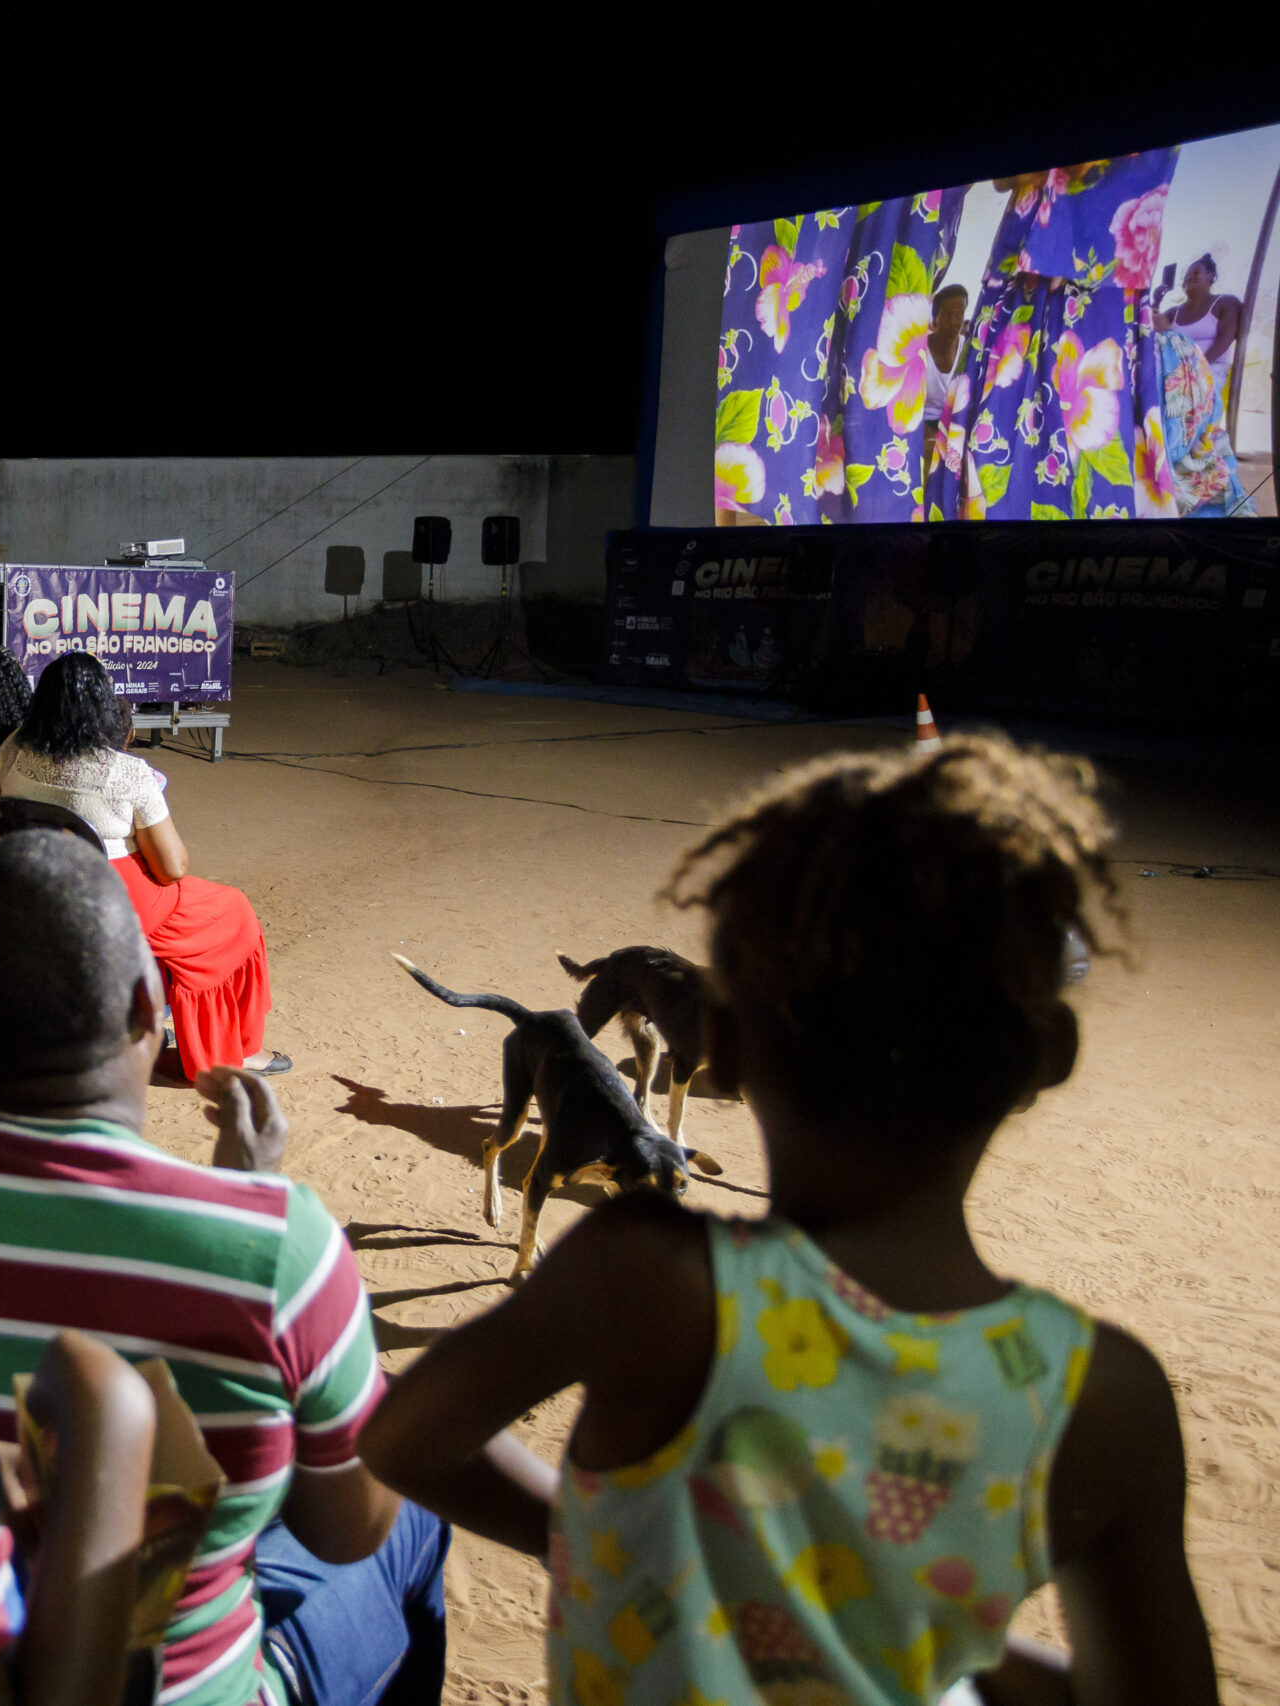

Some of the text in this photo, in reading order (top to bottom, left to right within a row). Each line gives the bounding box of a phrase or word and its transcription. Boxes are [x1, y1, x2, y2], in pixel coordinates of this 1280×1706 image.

[1025, 556, 1228, 596] CINEMA
[694, 588, 711, 599] NO
[713, 587, 734, 599] RIO
[23, 592, 218, 639] CINEMA
[26, 631, 216, 655] NO RIO SÃO FRANCISCO
[136, 661, 159, 670] 2024
